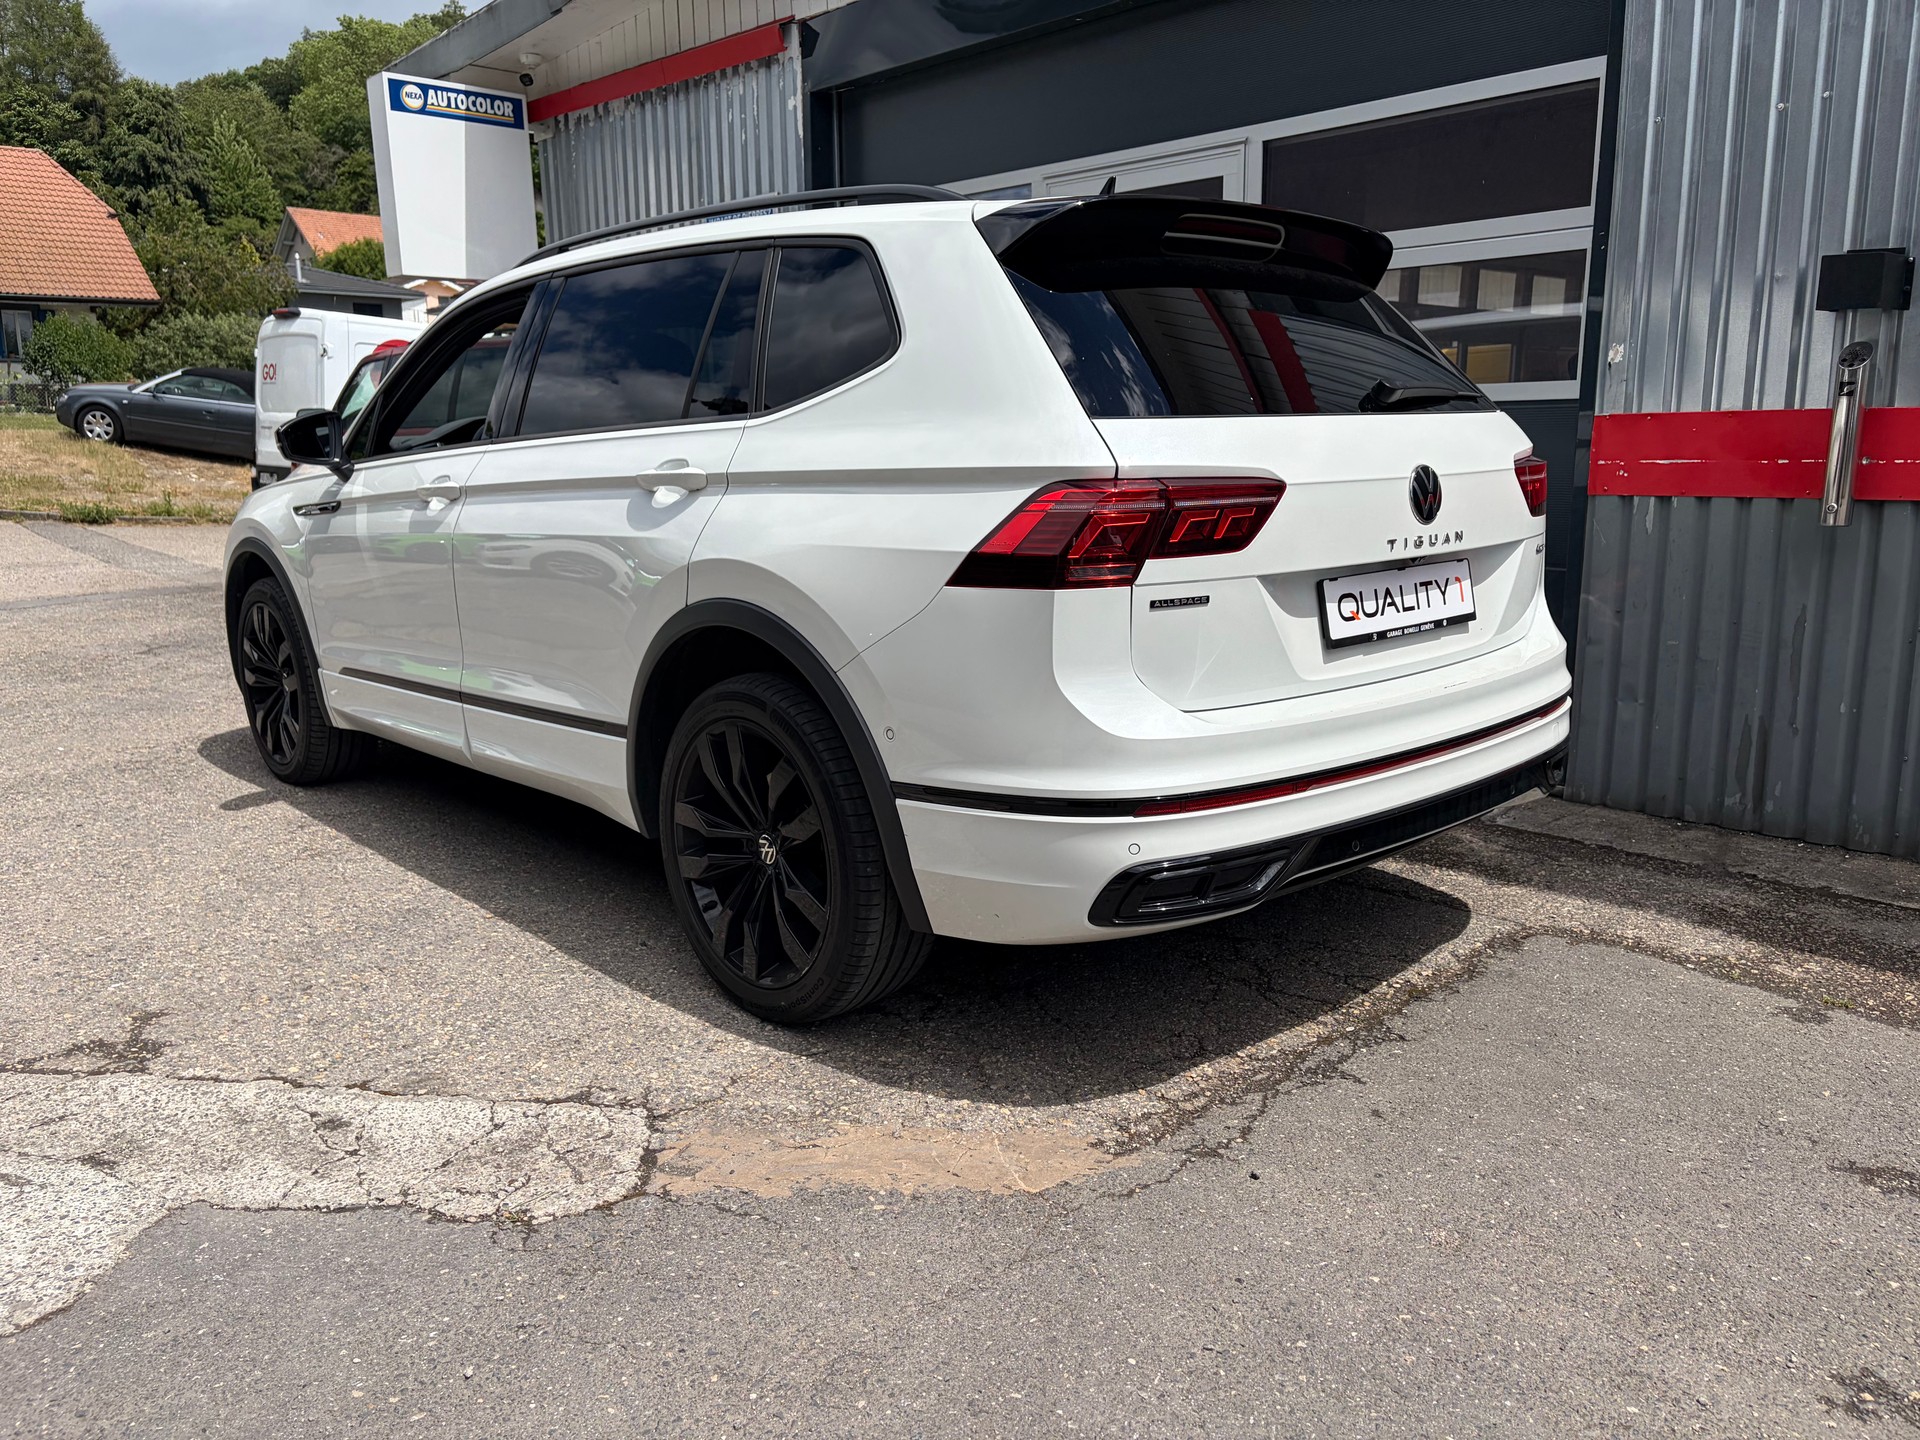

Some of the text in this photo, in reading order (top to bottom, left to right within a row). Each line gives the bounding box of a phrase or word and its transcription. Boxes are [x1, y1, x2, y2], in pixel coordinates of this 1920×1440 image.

[404, 89, 514, 117] NEXA AUTOCOLOR
[262, 363, 277, 381] GO!
[1387, 530, 1464, 552] TIGUAN
[1154, 596, 1208, 607] ALLSPACE
[1386, 629, 1403, 638] GARAGE
